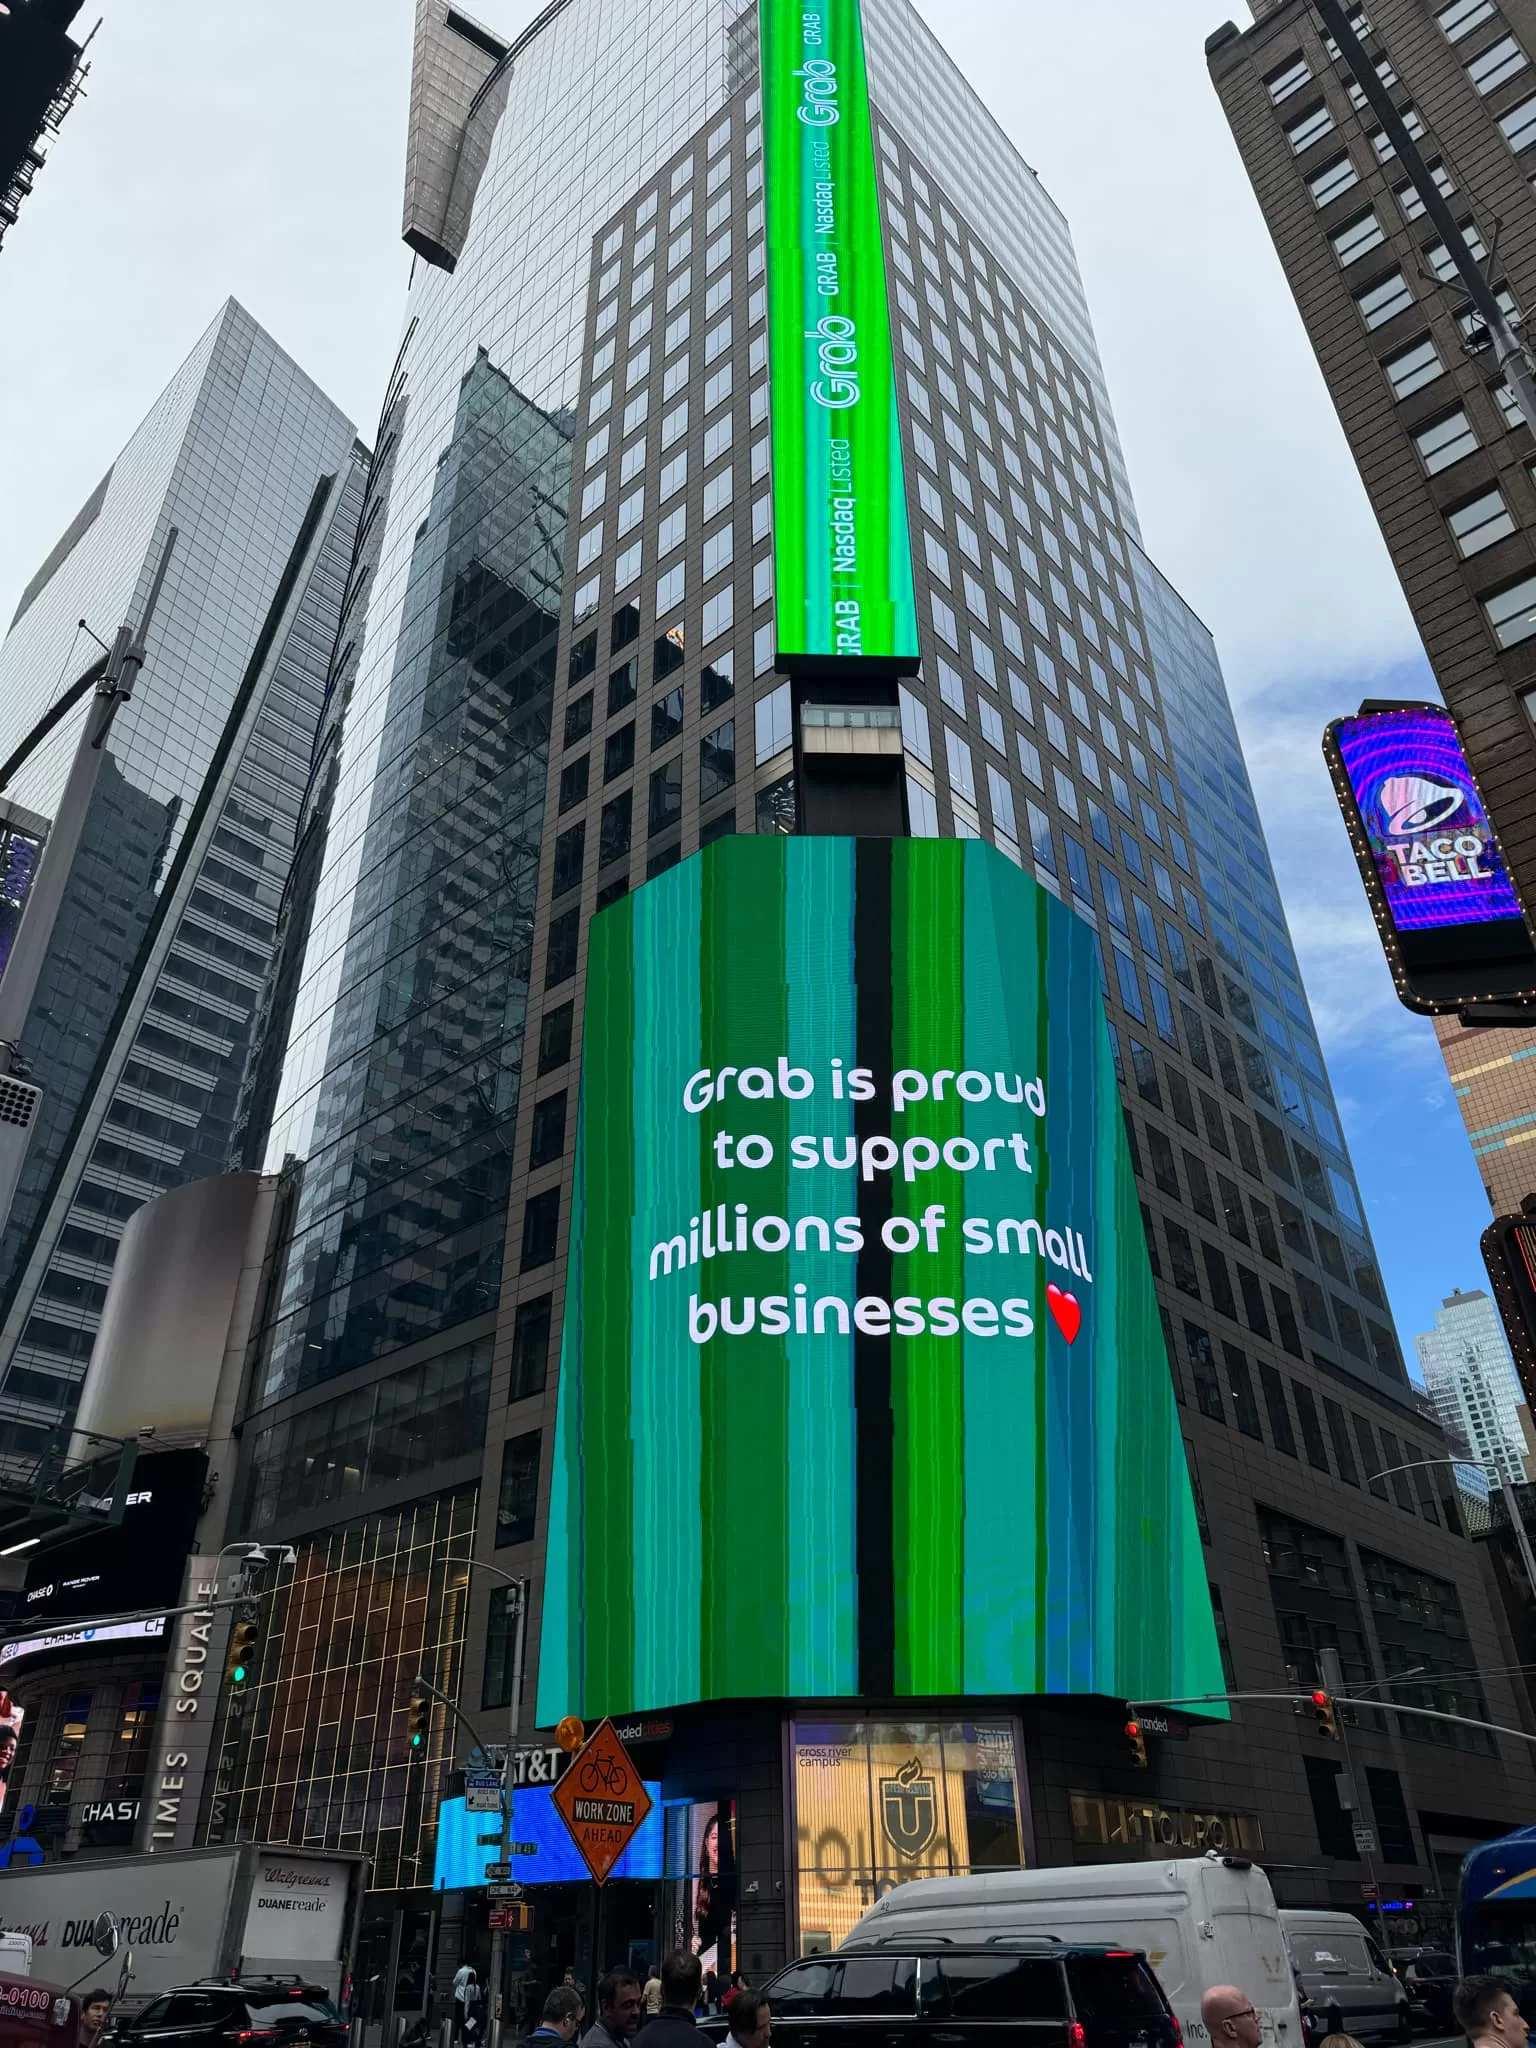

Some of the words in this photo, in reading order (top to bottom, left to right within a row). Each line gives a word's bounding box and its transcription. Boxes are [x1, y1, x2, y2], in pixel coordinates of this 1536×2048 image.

[803, 12, 822, 45] GRAB
[792, 59, 839, 126] Grab
[811, 141, 831, 181] Listed
[814, 182, 835, 234] Nasdaq
[816, 252, 839, 296] GRAB
[804, 315, 861, 409] Grab
[828, 438, 852, 493] Listed
[829, 497, 857, 572] Nasdaq
[1387, 835, 1484, 864] TACO
[1401, 857, 1492, 887] BELL
[683, 1057, 814, 1113] Grab
[830, 1058, 876, 1100] is
[892, 1069, 1046, 1117] proud
[713, 1131, 774, 1169] to
[791, 1132, 1033, 1182] support
[649, 1203, 864, 1280] millions
[881, 1205, 946, 1253] of
[963, 1217, 1093, 1283] small
[688, 1283, 1034, 1344] businesses
[125, 1491, 152, 1506] ER
[616, 1721, 643, 1739] nded
[799, 1748, 827, 1757] cross
[828, 1746, 852, 1757] river
[799, 1758, 841, 1769] campus
[150, 1751, 188, 1853] IMES
[575, 1800, 605, 1820] WORK
[606, 1804, 633, 1823] ZONE
[583, 1827, 622, 1844] AHEAD
[264, 1867, 331, 1889] Walgreens
[1186, 2019, 1208, 2039] Inc.
